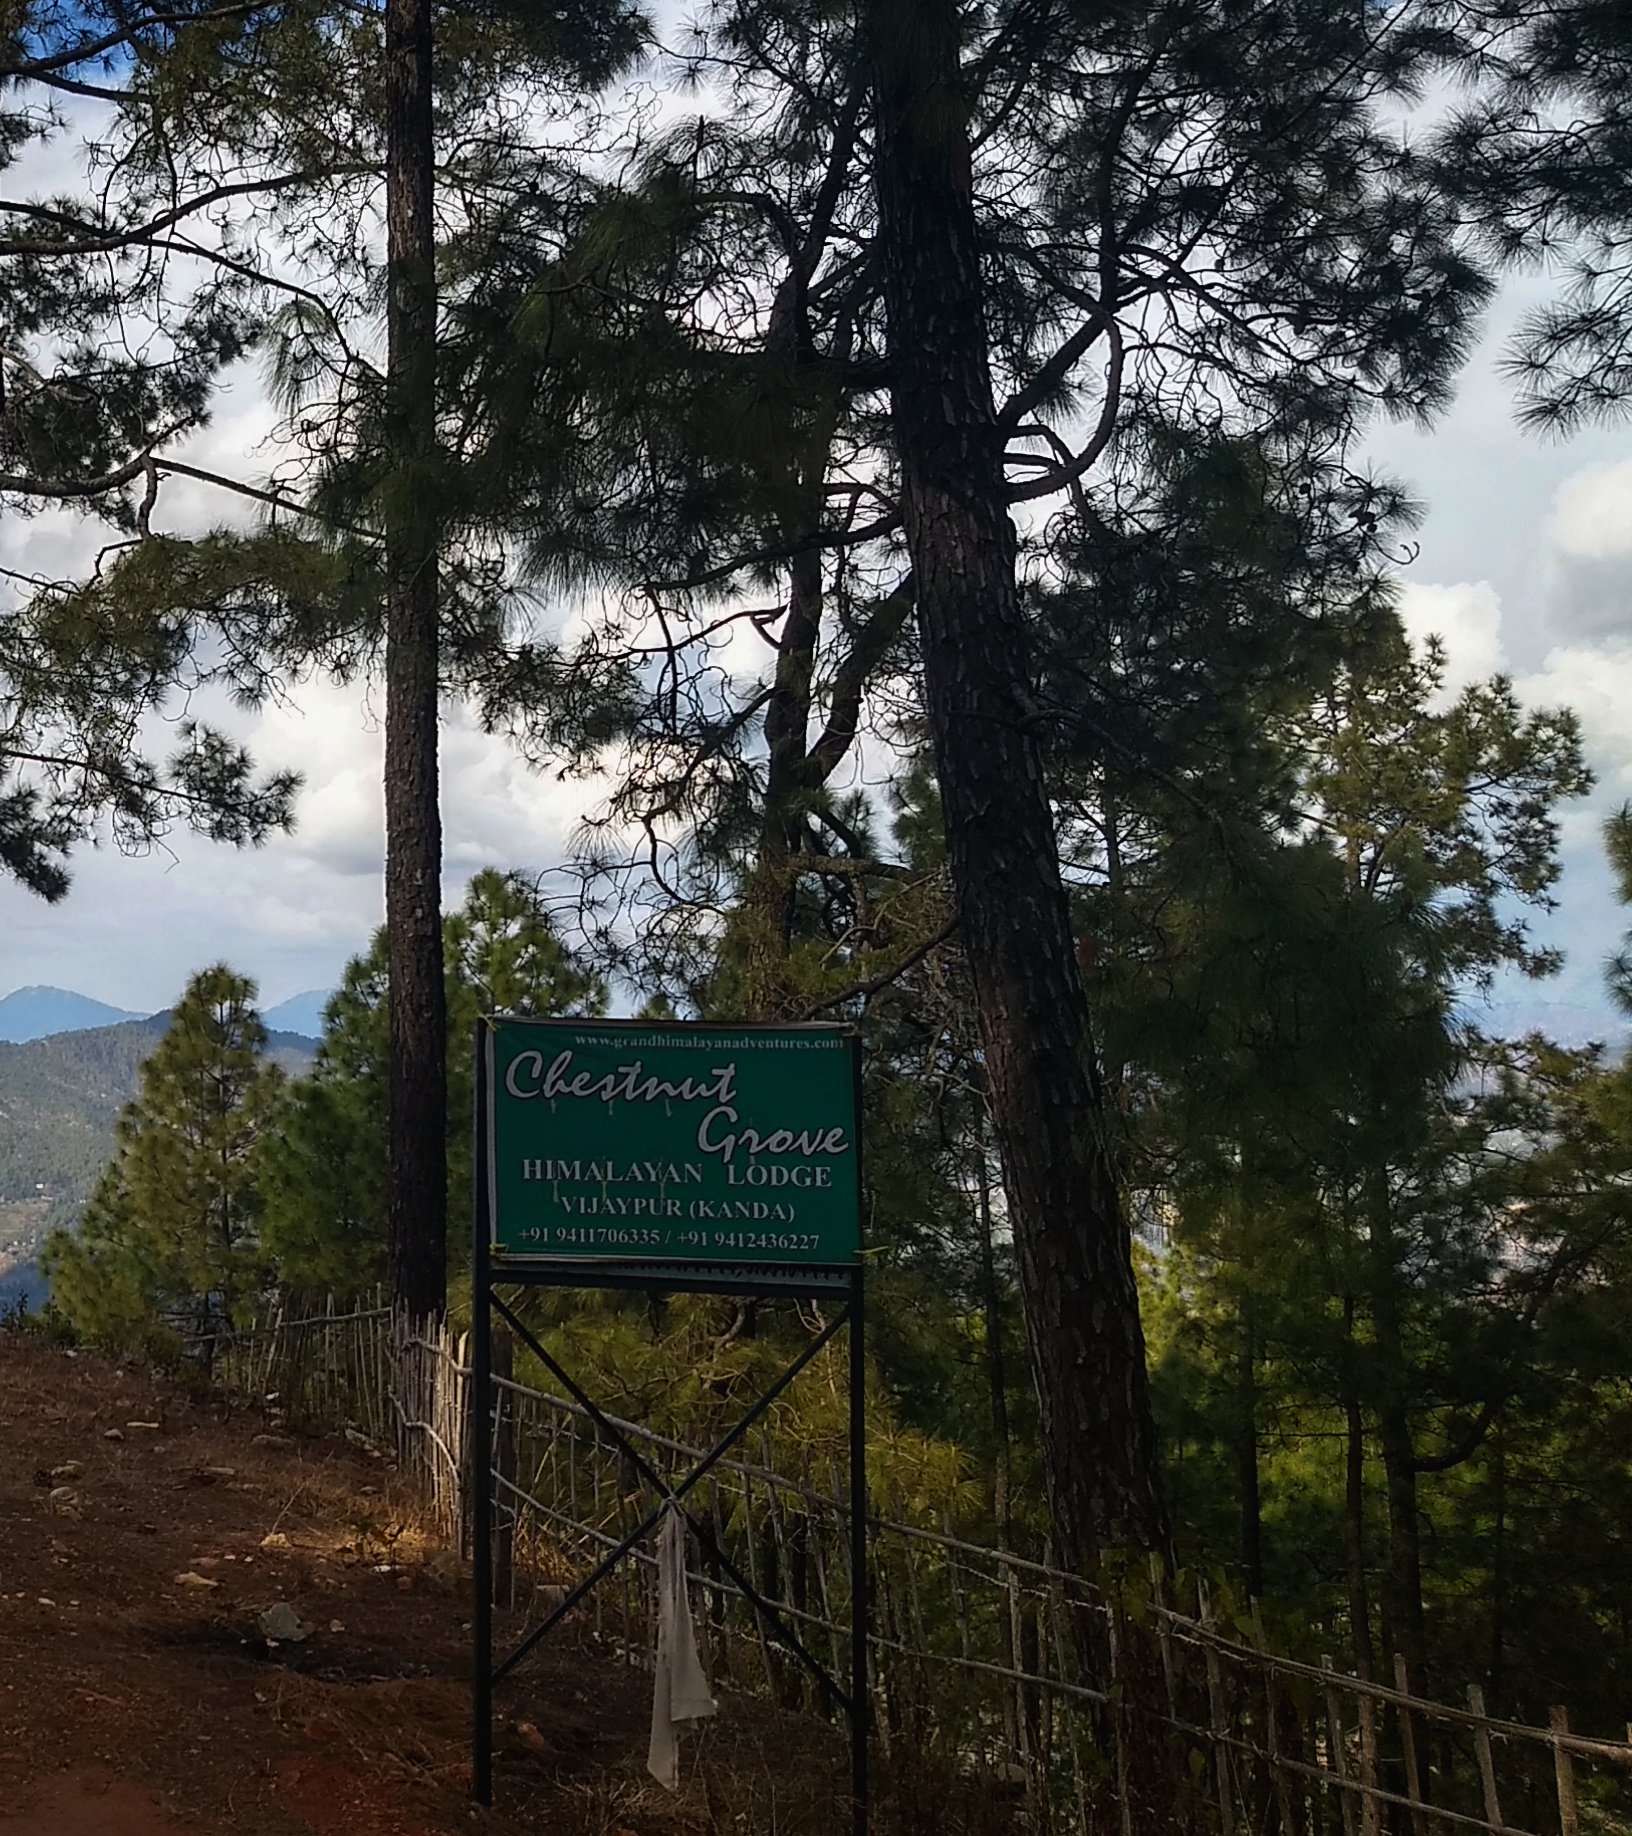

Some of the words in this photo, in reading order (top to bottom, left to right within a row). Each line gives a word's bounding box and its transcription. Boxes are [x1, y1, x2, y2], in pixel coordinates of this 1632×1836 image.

[574, 1034, 844, 1051] www.grandhimalayanadventures.com
[505, 1050, 737, 1103] Chestnut
[697, 1106, 850, 1163] Grove
[523, 1158, 703, 1184] HIMALAYAN
[727, 1164, 833, 1188] LODGE
[561, 1195, 683, 1217] VIJAYPUR
[689, 1199, 796, 1224] (KANDA)
[518, 1226, 550, 1243] +91
[556, 1227, 661, 1245] 9411706335
[676, 1230, 709, 1247] +91
[714, 1231, 819, 1250] 9412436227
